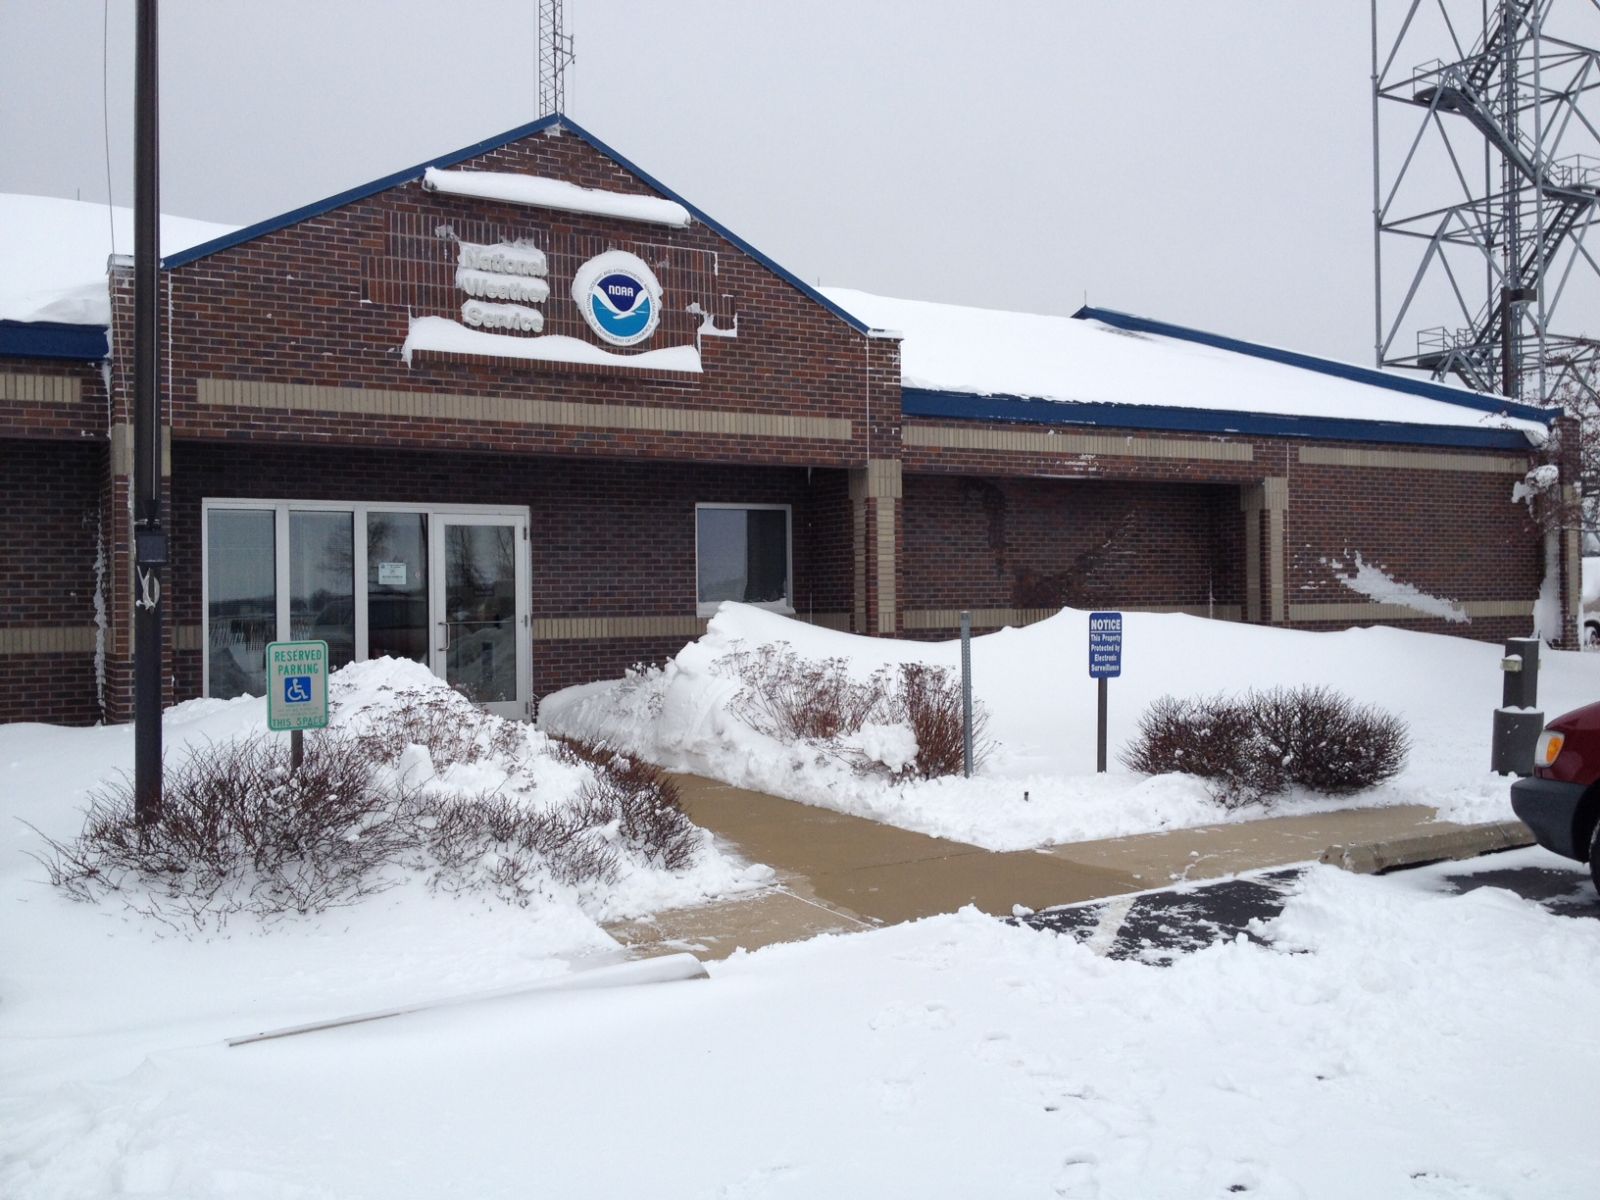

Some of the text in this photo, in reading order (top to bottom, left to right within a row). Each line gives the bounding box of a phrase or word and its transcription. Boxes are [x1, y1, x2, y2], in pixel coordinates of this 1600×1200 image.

[465, 249, 548, 277] National
[463, 277, 548, 303] Weather
[608, 285, 634, 297] NOAA
[466, 306, 544, 333] Service
[1091, 619, 1121, 630] NOTICE
[1091, 633, 1121, 642] This Property
[1091, 644, 1120, 652] Protected by
[274, 649, 322, 662] RESERVED
[1094, 654, 1117, 662] Electronic
[278, 663, 319, 675] PARKING
[1091, 663, 1119, 672] Surveillance
[272, 715, 323, 727] THIS SPACE
